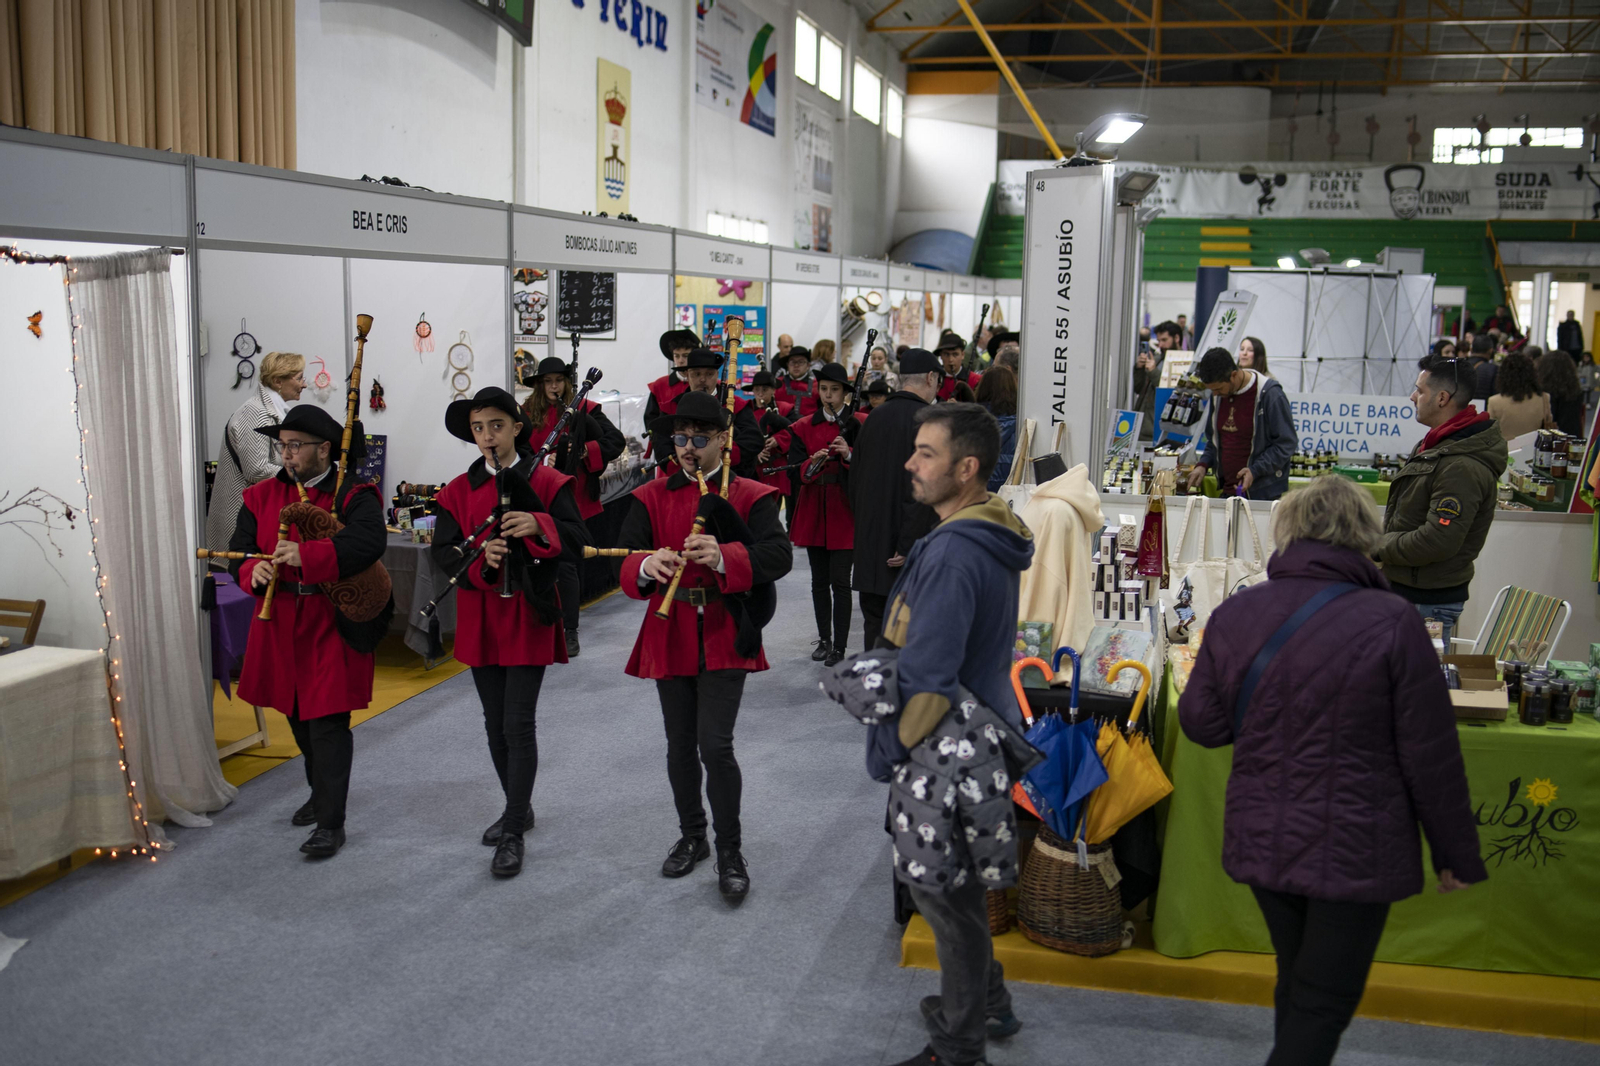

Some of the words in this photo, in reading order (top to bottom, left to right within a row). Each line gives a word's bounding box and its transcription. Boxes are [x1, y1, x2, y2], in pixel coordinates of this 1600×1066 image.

[1036, 180, 1046, 192] 48
[1309, 180, 1360, 192] FORTE
[1495, 172, 1552, 188] SUDA
[1497, 189, 1548, 199] SONRIE
[1308, 201, 1360, 210] EXCUSAS
[196, 221, 206, 235] 12
[353, 209, 374, 231] BEA
[376, 212, 383, 232] E
[385, 213, 408, 234] CRIS
[565, 234, 598, 252] BOMBOCAS
[599, 235, 614, 253] JÚLIO
[615, 240, 638, 255] ANTUNES
[560, 289, 567, 299] 6
[1055, 317, 1070, 340] 55
[1051, 346, 1068, 427] TALLER
[1290, 401, 1332, 416] ERRA
[1339, 403, 1360, 418] DE
[1367, 404, 1414, 419] BARO
[1292, 418, 1401, 437] GRICULTURA
[1296, 433, 1369, 453] GÁNICA
